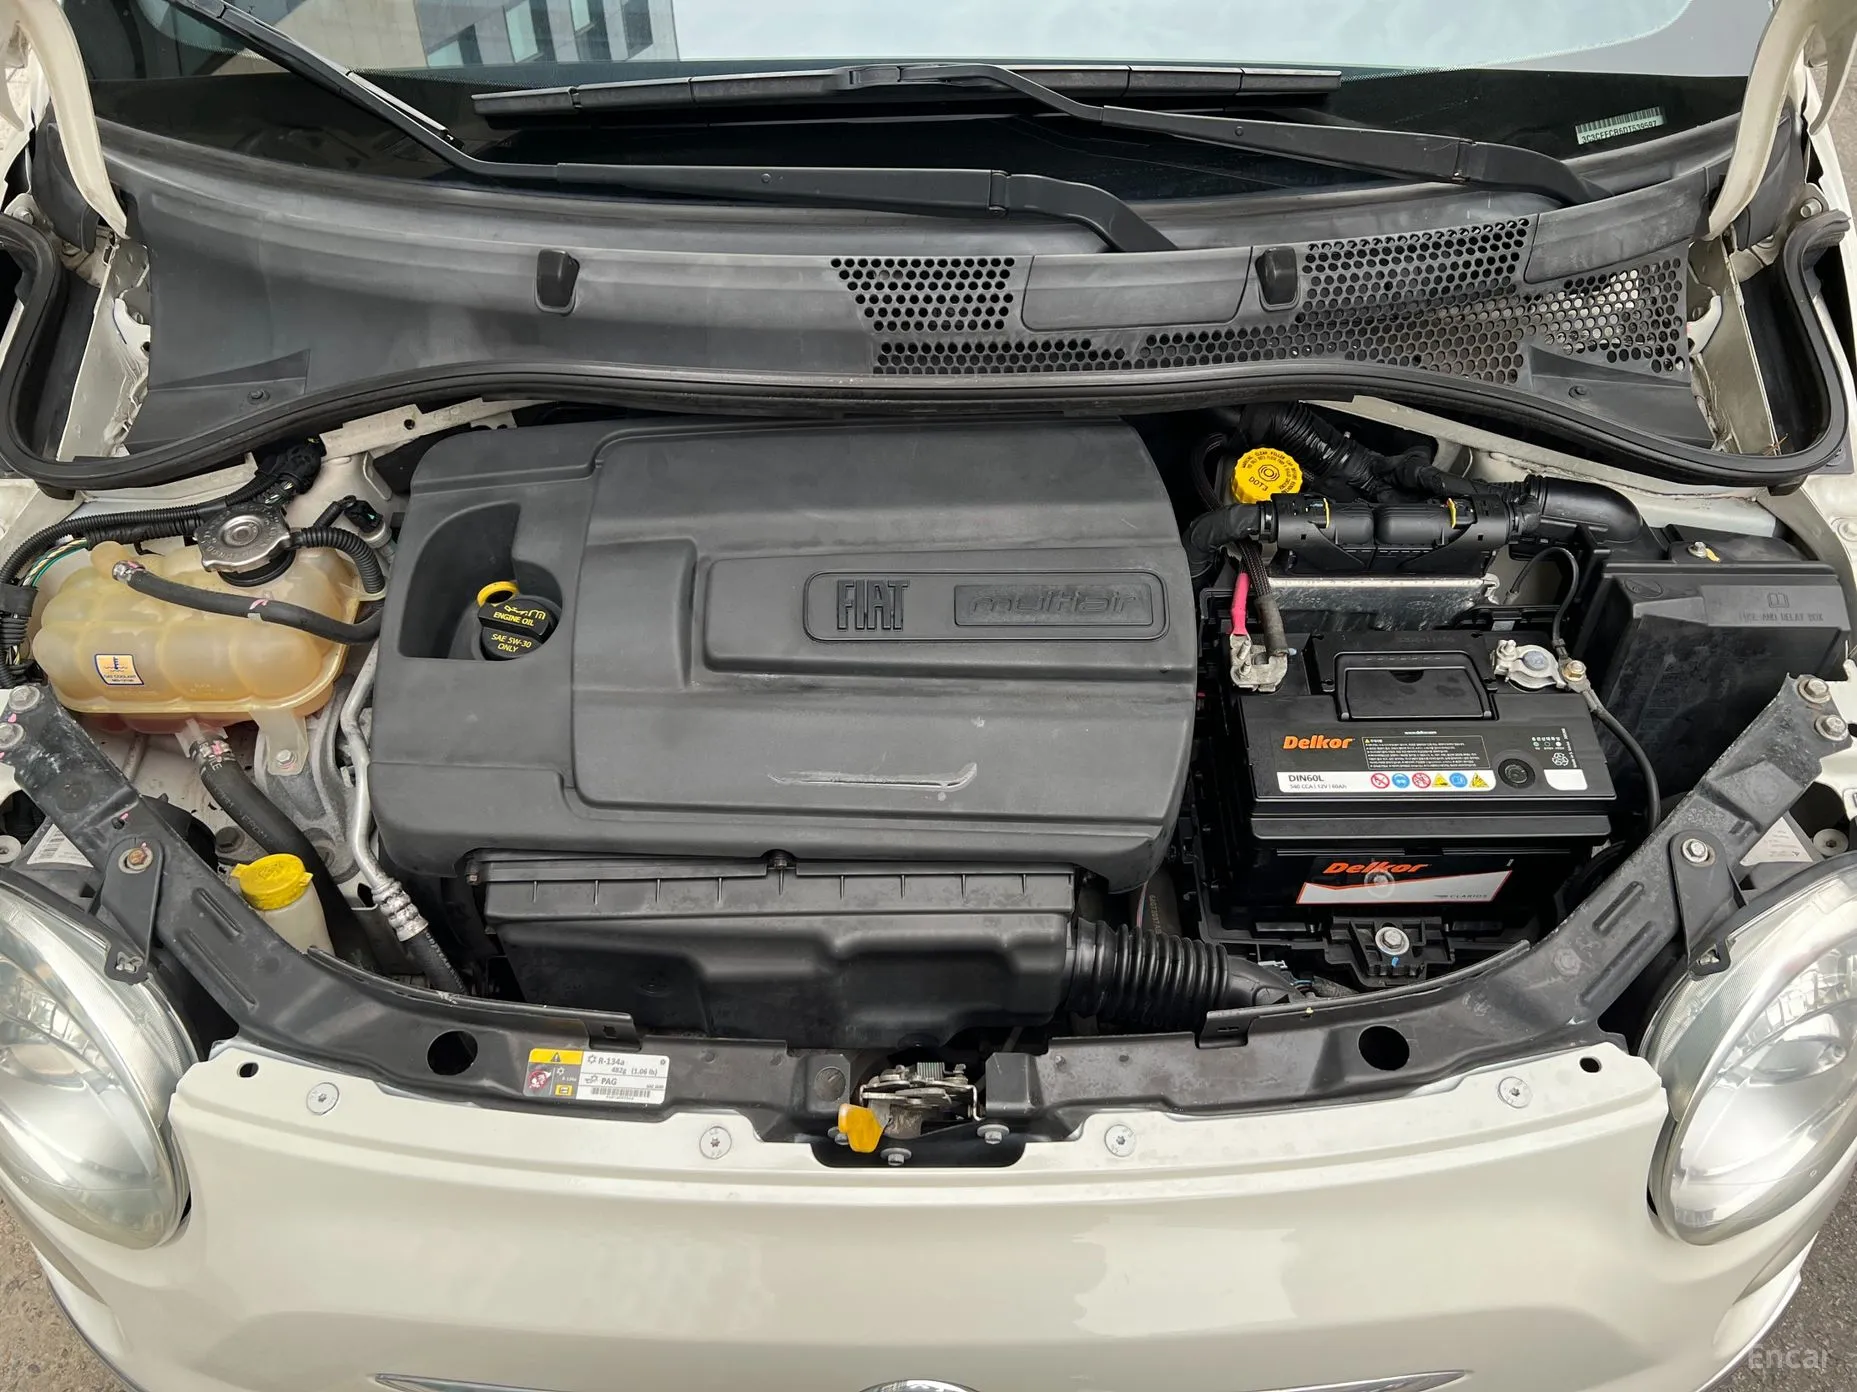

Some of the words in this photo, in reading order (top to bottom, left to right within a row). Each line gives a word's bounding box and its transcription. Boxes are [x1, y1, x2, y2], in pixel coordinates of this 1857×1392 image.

[836, 579, 910, 631] FIAT
[493, 611, 522, 624] ENGINE
[521, 617, 535, 627] OIL
[491, 633, 507, 643] SAE
[507, 637, 532, 649] 5W-30
[497, 643, 519, 653] ONLY
[1283, 735, 1354, 749] Delkor
[1288, 774, 1324, 782] DIN60L
[1322, 860, 1430, 875] Delkor
[597, 1056, 625, 1066] R-134a
[600, 1077, 618, 1086] PAG
